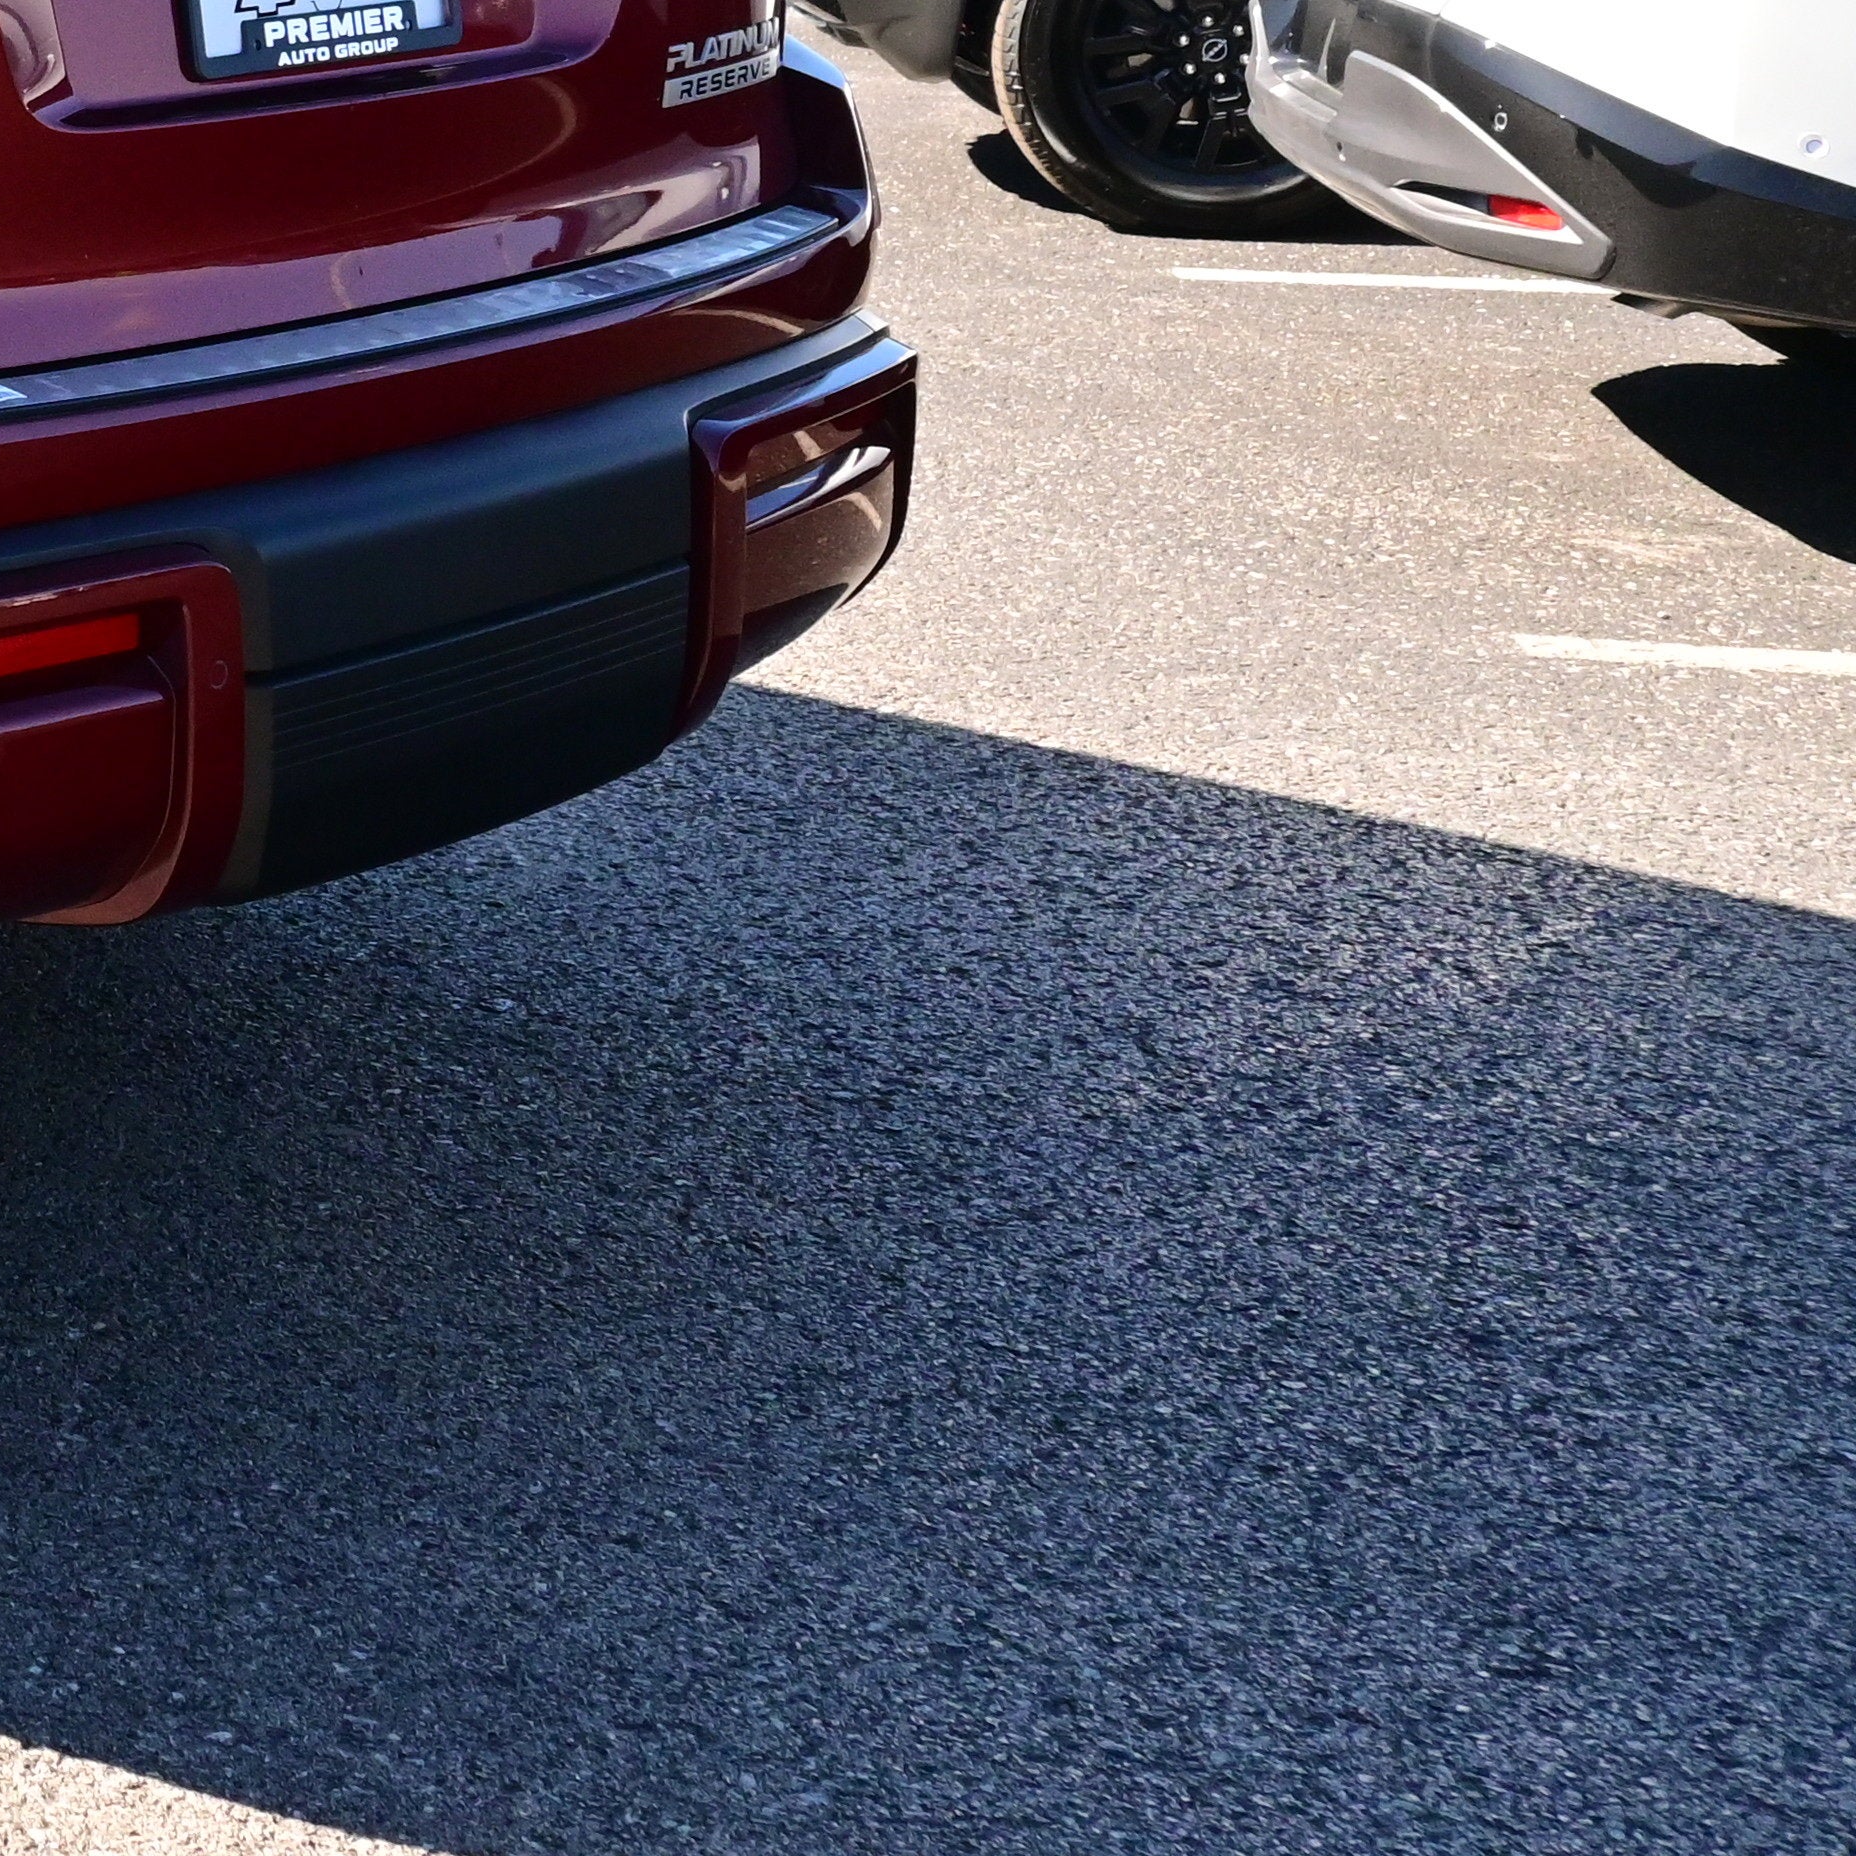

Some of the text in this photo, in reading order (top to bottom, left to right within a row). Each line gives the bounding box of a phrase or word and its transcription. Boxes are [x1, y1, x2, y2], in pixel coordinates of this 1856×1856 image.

[262, 4, 406, 48] PREMIER
[666, 16, 780, 73] PLATINUM
[277, 37, 399, 67] AUTO GROUP
[679, 57, 771, 100] RESERVE
